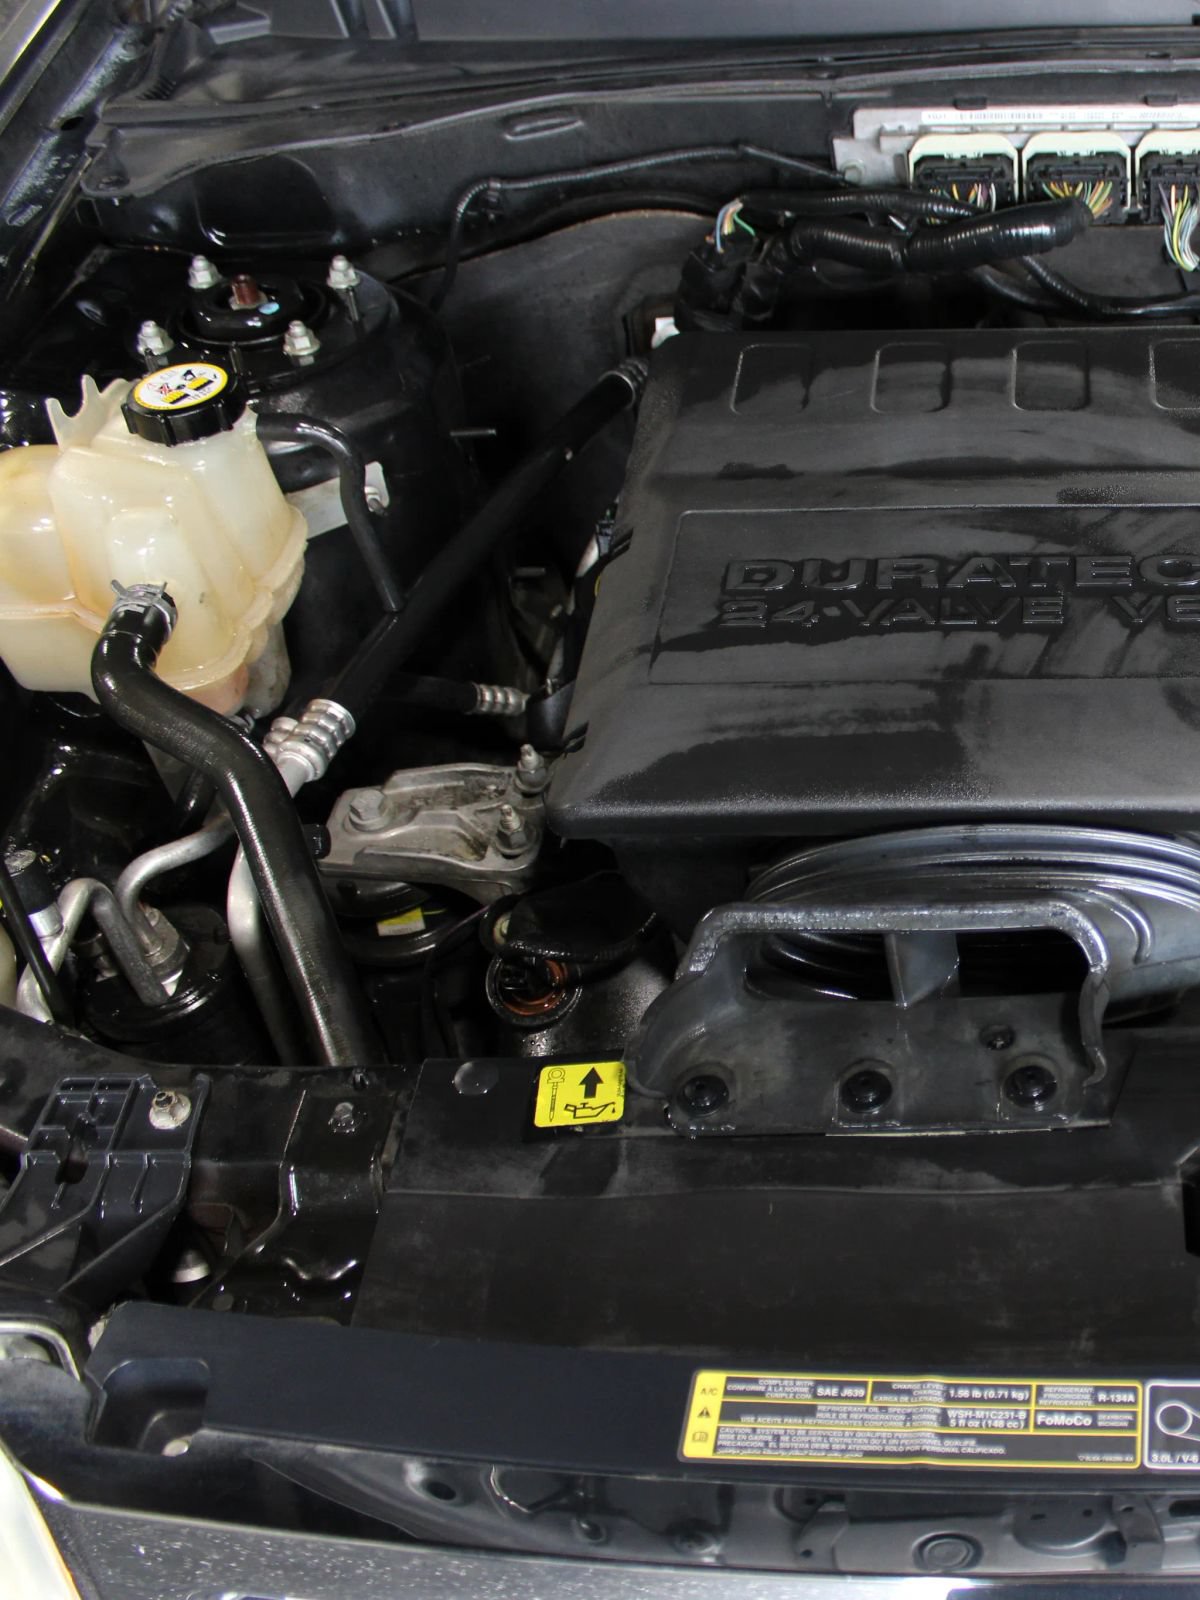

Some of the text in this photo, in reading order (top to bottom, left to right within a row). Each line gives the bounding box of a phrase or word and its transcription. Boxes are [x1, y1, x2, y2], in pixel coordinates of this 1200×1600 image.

[700, 1387, 718, 1396] A/C
[727, 1384, 765, 1392] CONFORME
[817, 1386, 866, 1398] SAE J639
[949, 1388, 1030, 1401] 1.56 lb (0.71 kg)
[1097, 1392, 1136, 1403] R-134A
[950, 1420, 957, 1428] 5
[958, 1419, 966, 1428] fl
[982, 1420, 1005, 1429] (148
[1007, 1421, 1025, 1430] cc)
[1036, 1413, 1092, 1427] FoMoCo
[1151, 1453, 1173, 1463] 3.0L
[1181, 1454, 1199, 1464] V-6
